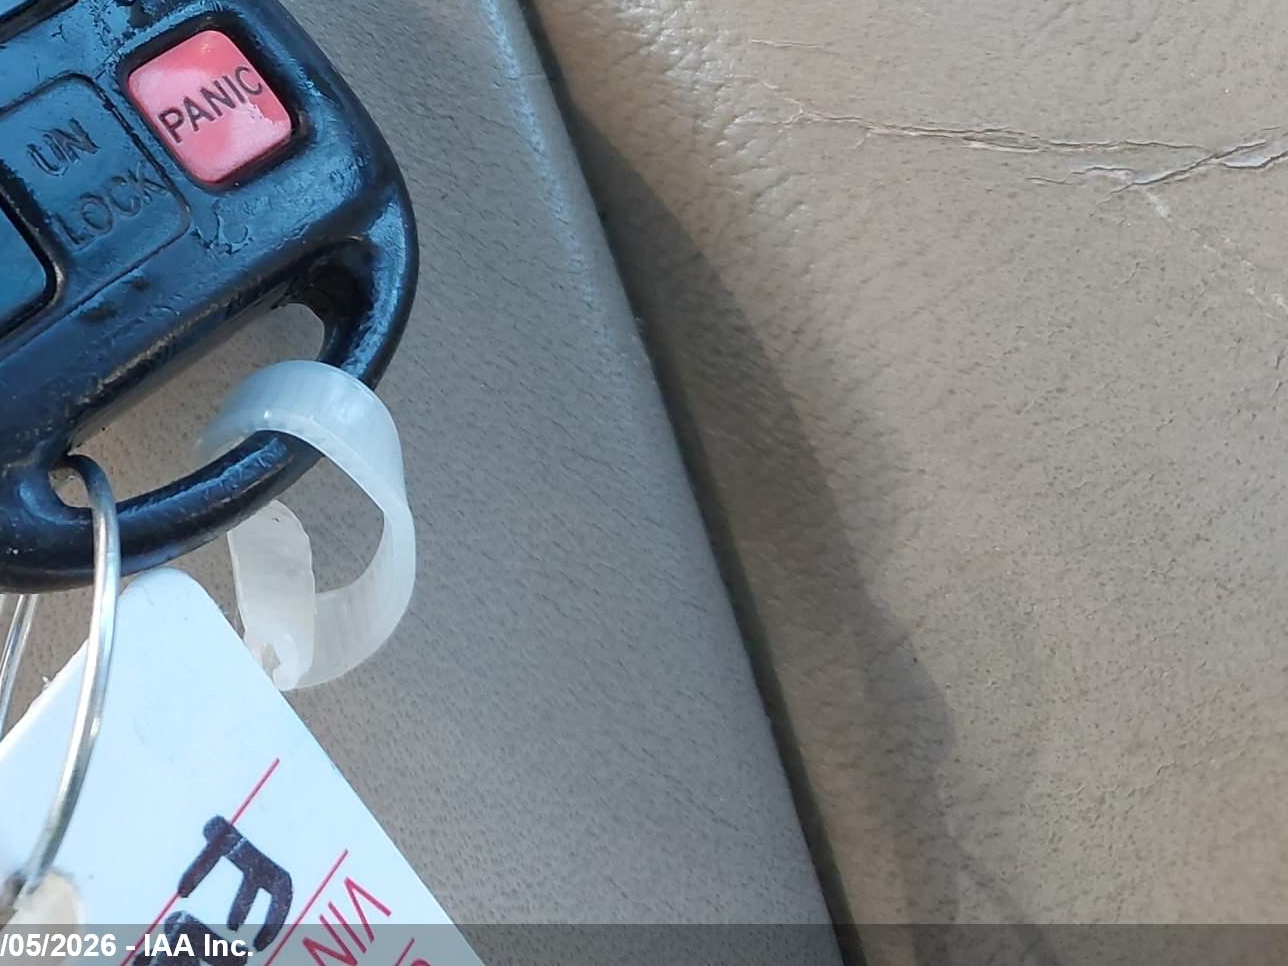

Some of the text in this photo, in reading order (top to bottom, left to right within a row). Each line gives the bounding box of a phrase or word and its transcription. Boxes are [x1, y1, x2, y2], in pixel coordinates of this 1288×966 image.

[158, 65, 263, 144] PANIC
[26, 117, 99, 177] UN
[50, 162, 169, 249] LOCK
[302, 877, 392, 966] VIN
